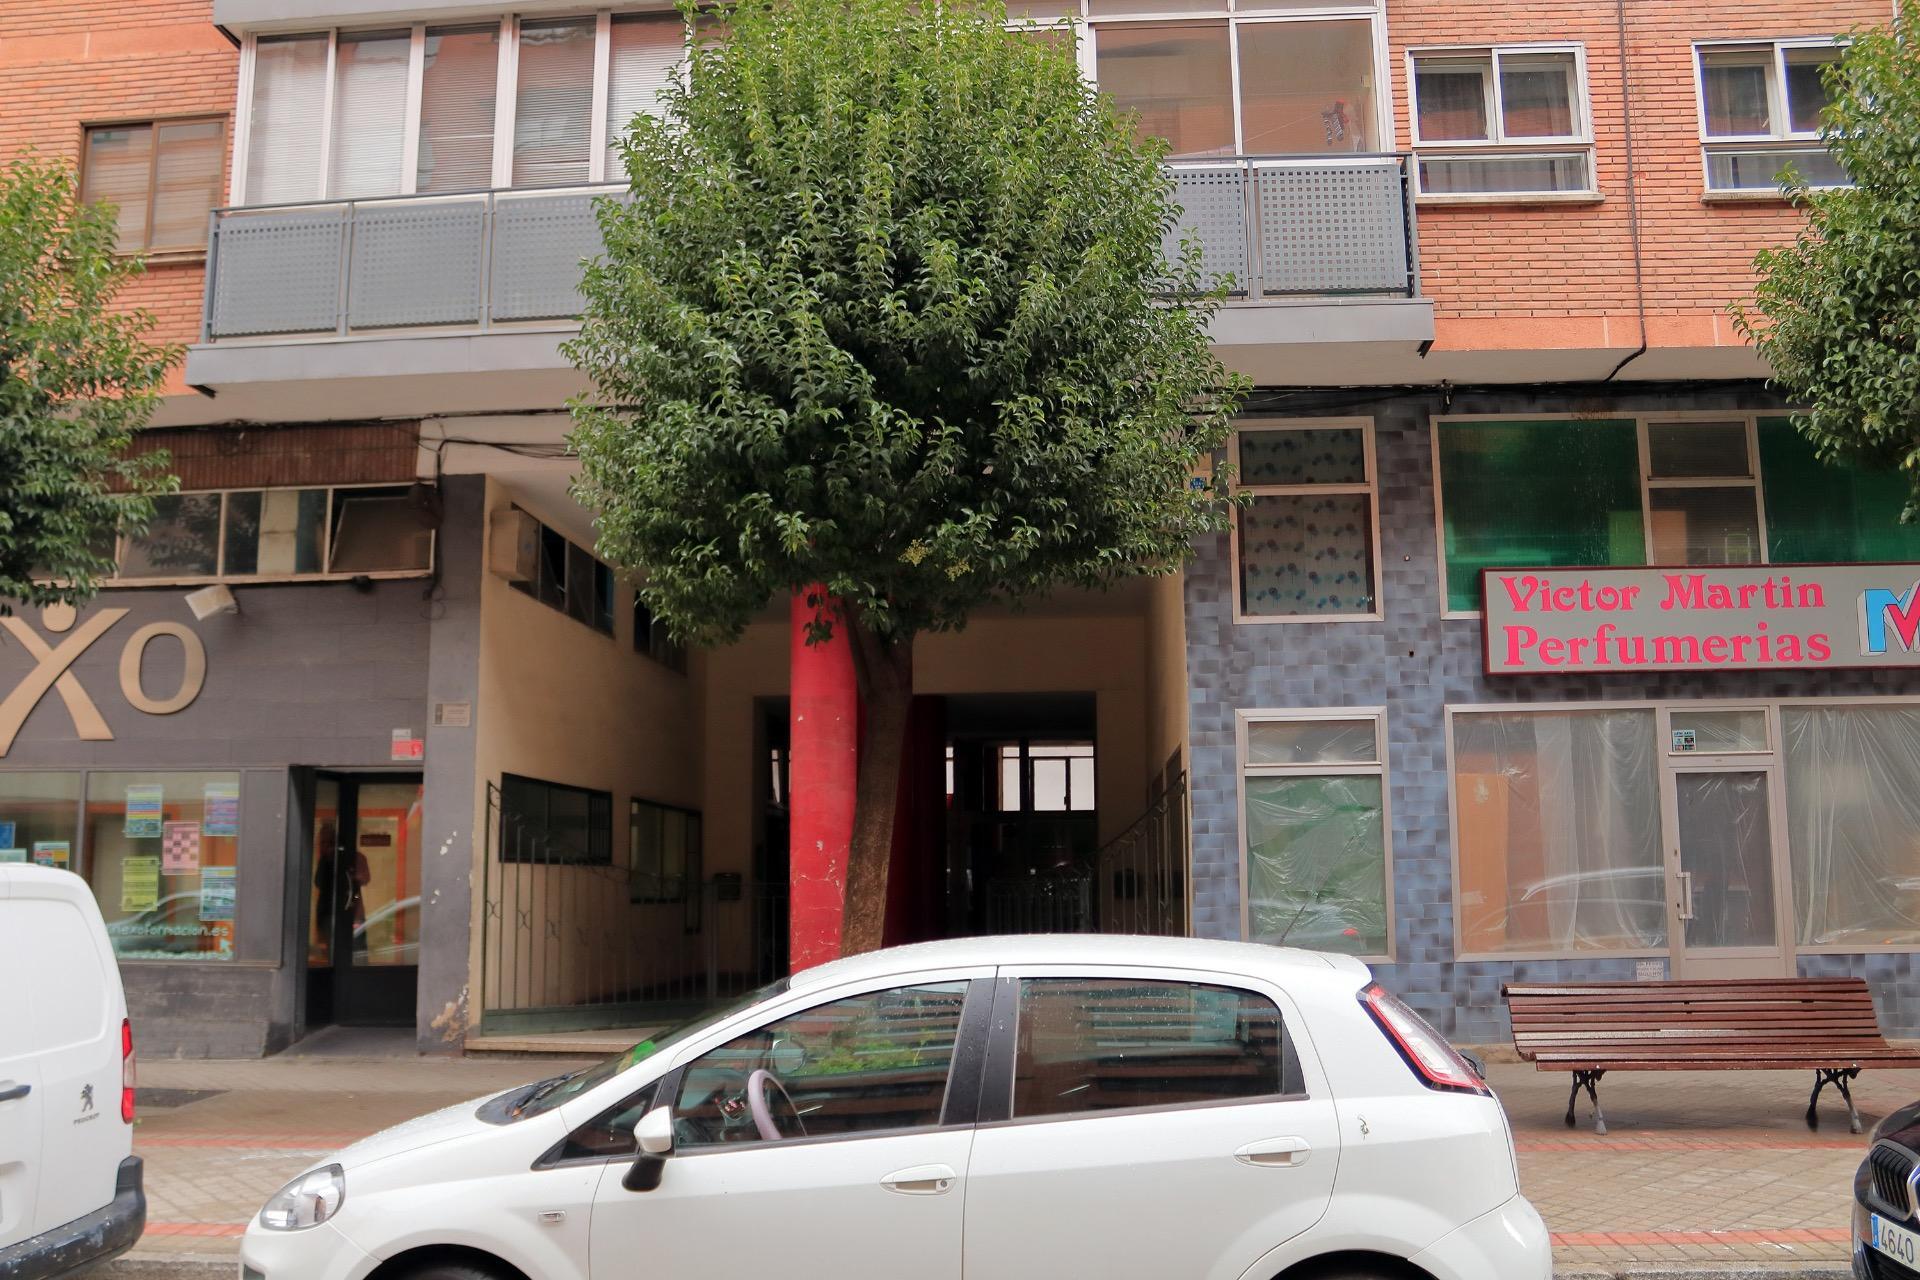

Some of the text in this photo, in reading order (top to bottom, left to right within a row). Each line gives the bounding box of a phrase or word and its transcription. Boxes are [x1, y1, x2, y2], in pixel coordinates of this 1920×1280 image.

[1499, 574, 1826, 612] Victor Martin
[1502, 622, 1832, 666] Perfumerias
[1881, 1223, 1914, 1264] 4640
